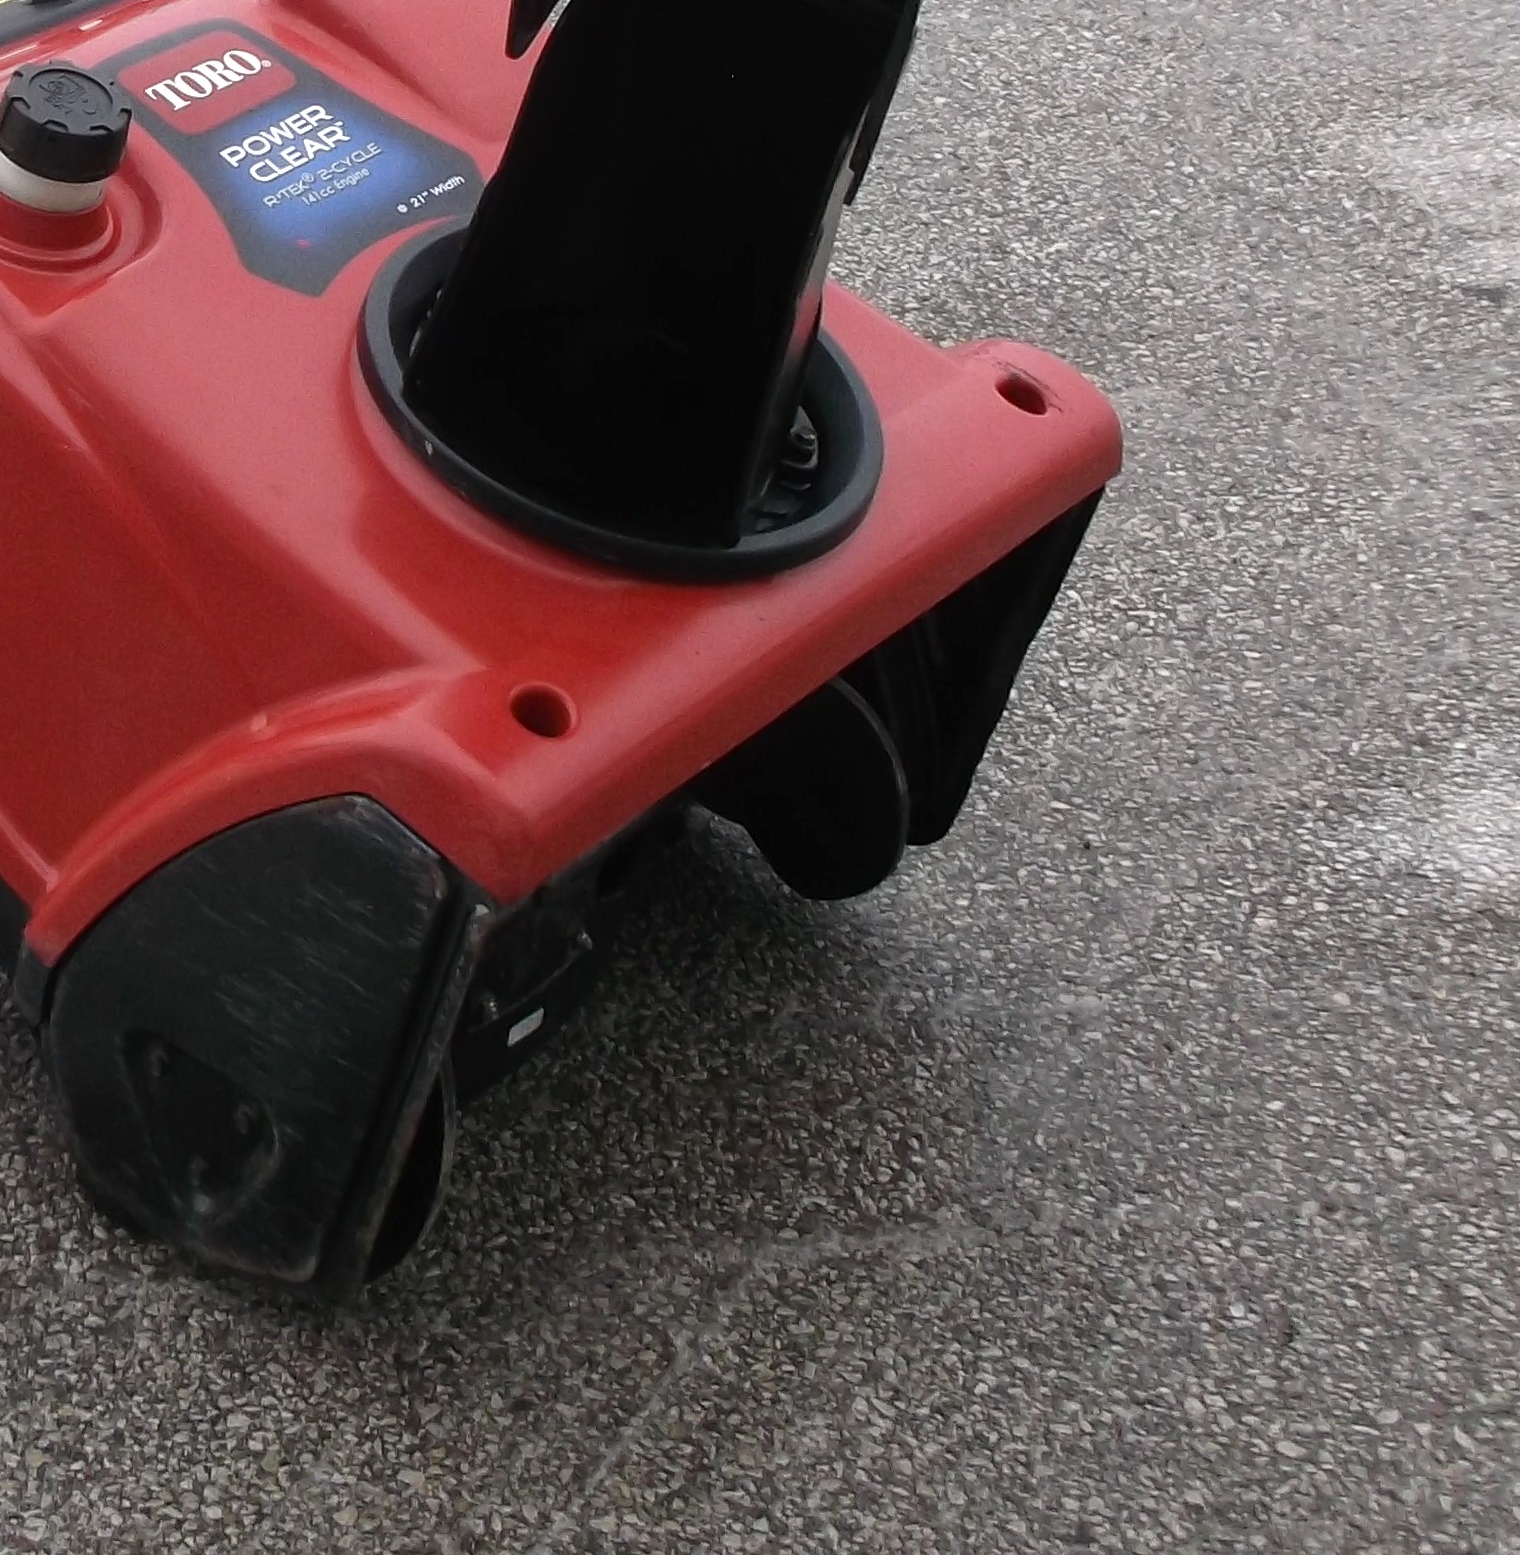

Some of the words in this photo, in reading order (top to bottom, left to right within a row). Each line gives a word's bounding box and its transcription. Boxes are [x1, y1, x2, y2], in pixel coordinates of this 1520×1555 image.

[219, 105, 333, 167] POWER
[316, 142, 383, 181] 2-CYCLE
[334, 166, 371, 192] Engine
[426, 174, 467, 198] Width
